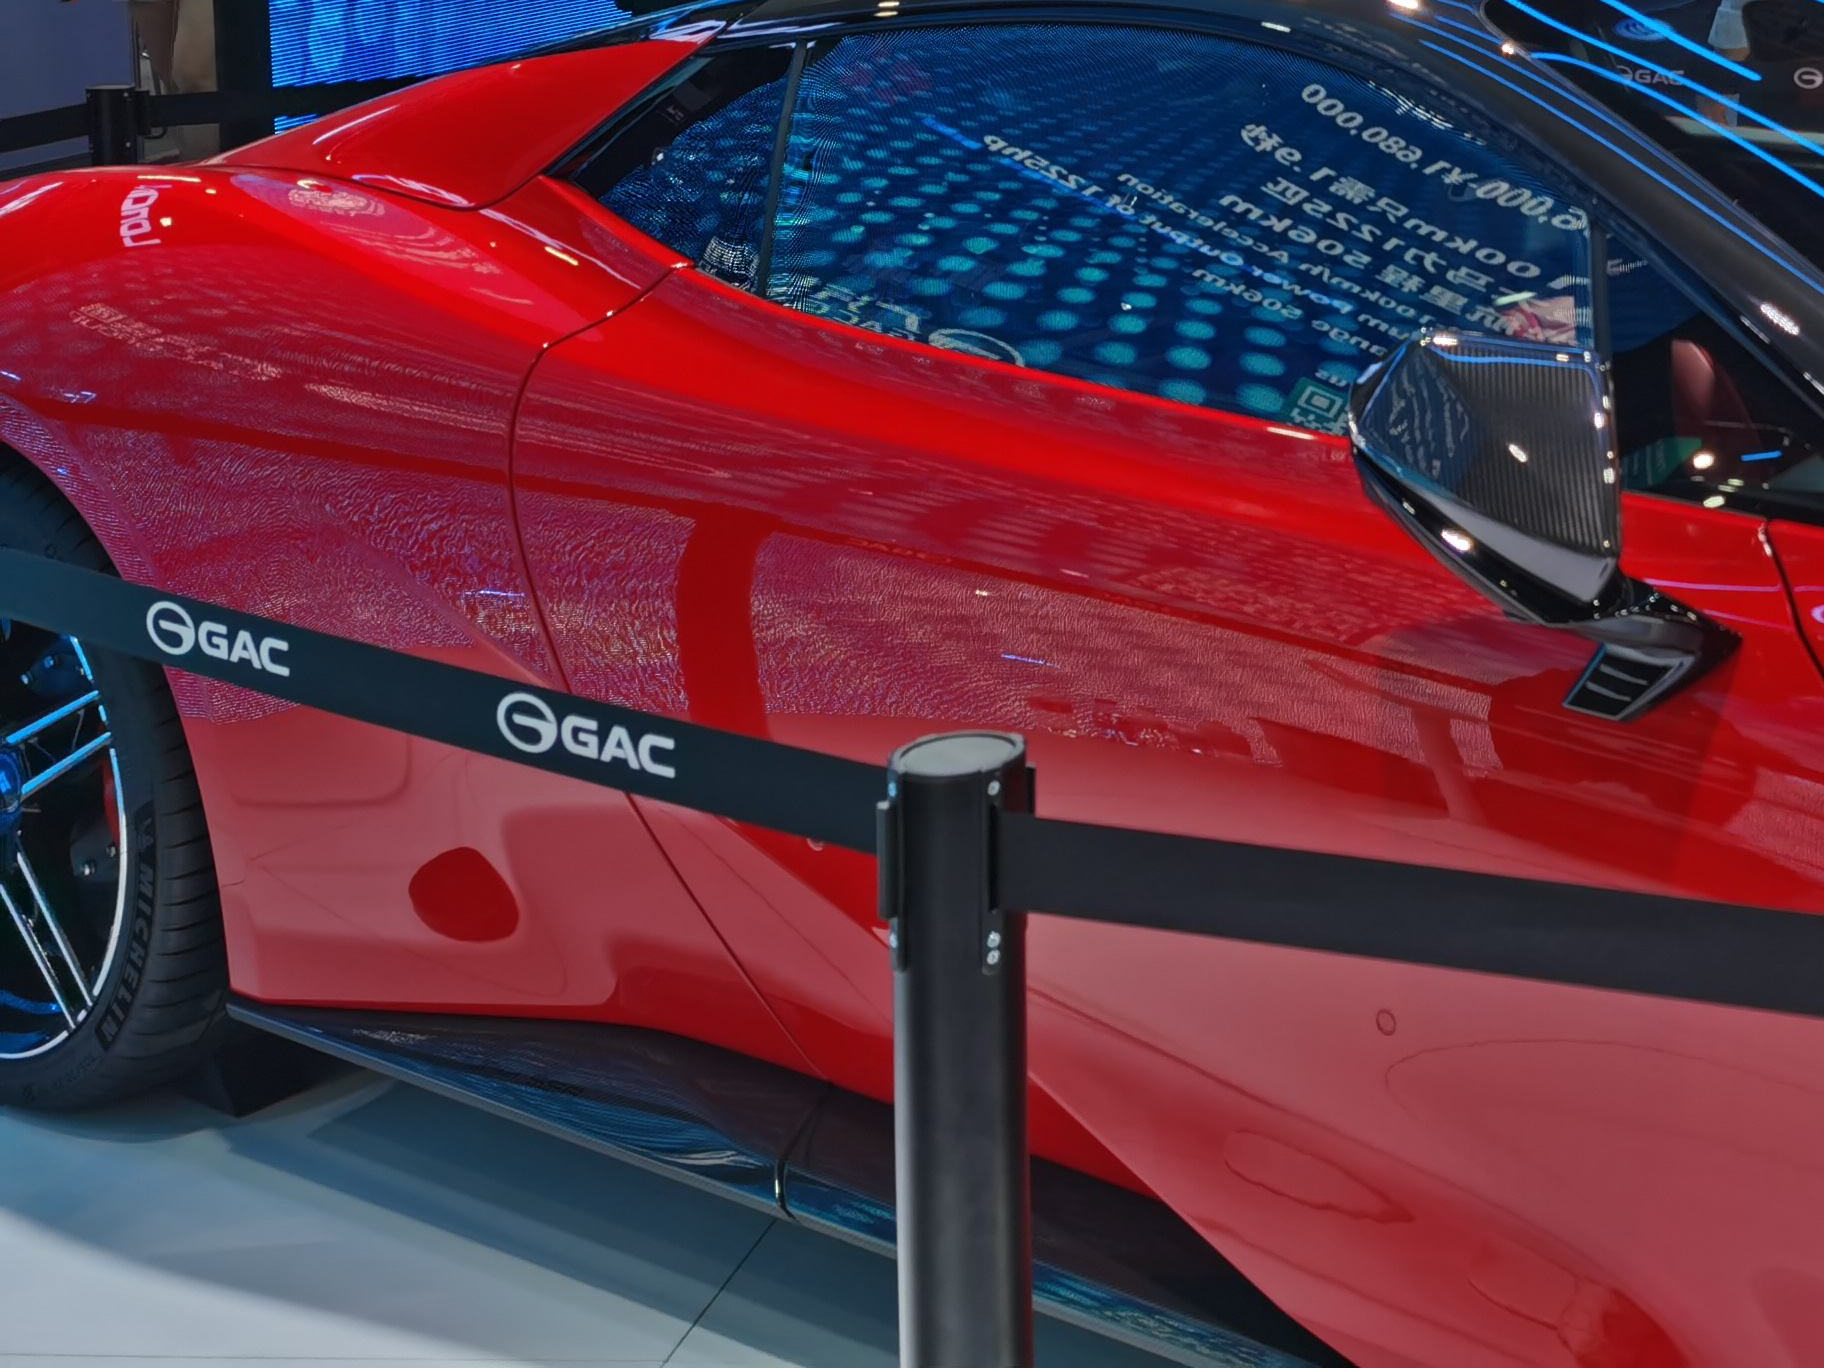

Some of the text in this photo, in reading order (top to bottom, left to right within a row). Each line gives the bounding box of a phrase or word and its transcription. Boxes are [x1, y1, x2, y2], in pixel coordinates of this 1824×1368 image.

[197, 619, 291, 677] GAC
[560, 714, 677, 779] GAC
[99, 863, 155, 1048] MICHELIN
